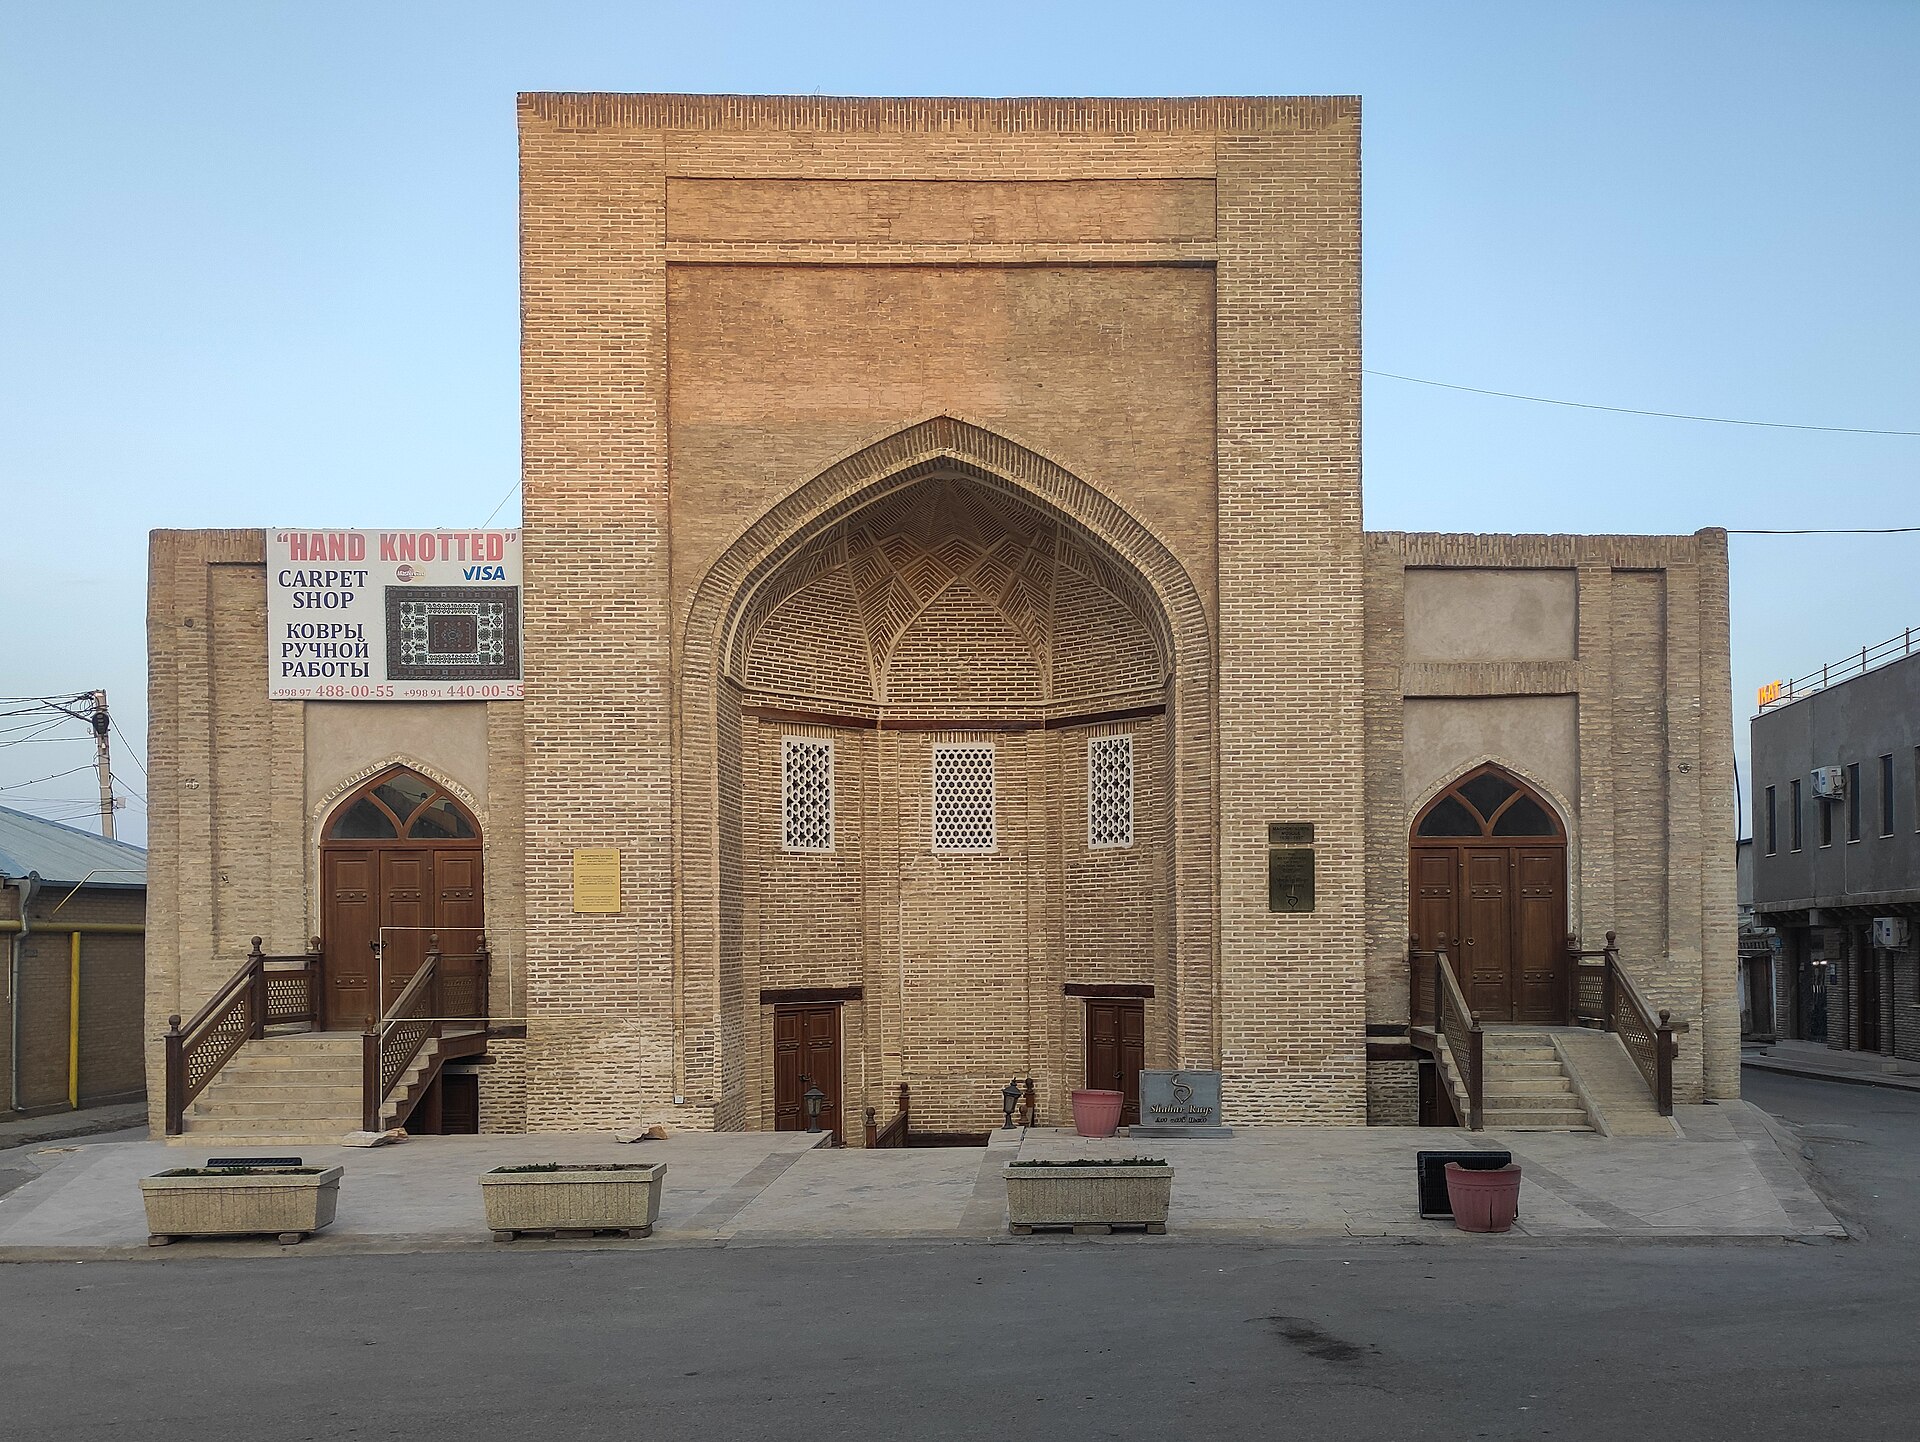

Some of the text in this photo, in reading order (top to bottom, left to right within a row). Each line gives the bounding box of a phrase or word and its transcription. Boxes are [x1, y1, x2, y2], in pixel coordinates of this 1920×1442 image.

[276, 532, 517, 562] “HAND KNOTTED”
[278, 569, 368, 588] CARPET
[462, 565, 506, 581] VISA
[292, 591, 354, 609] SHOP
[286, 623, 364, 639] КОВРЫ
[281, 638, 370, 658] РУЧНОЙ
[281, 661, 370, 678] РАБОТЫ
[272, 685, 524, 698] +998 97 488-00-55 +998 91 440-00-55
[1188, 1104, 1213, 1117] Rugs
